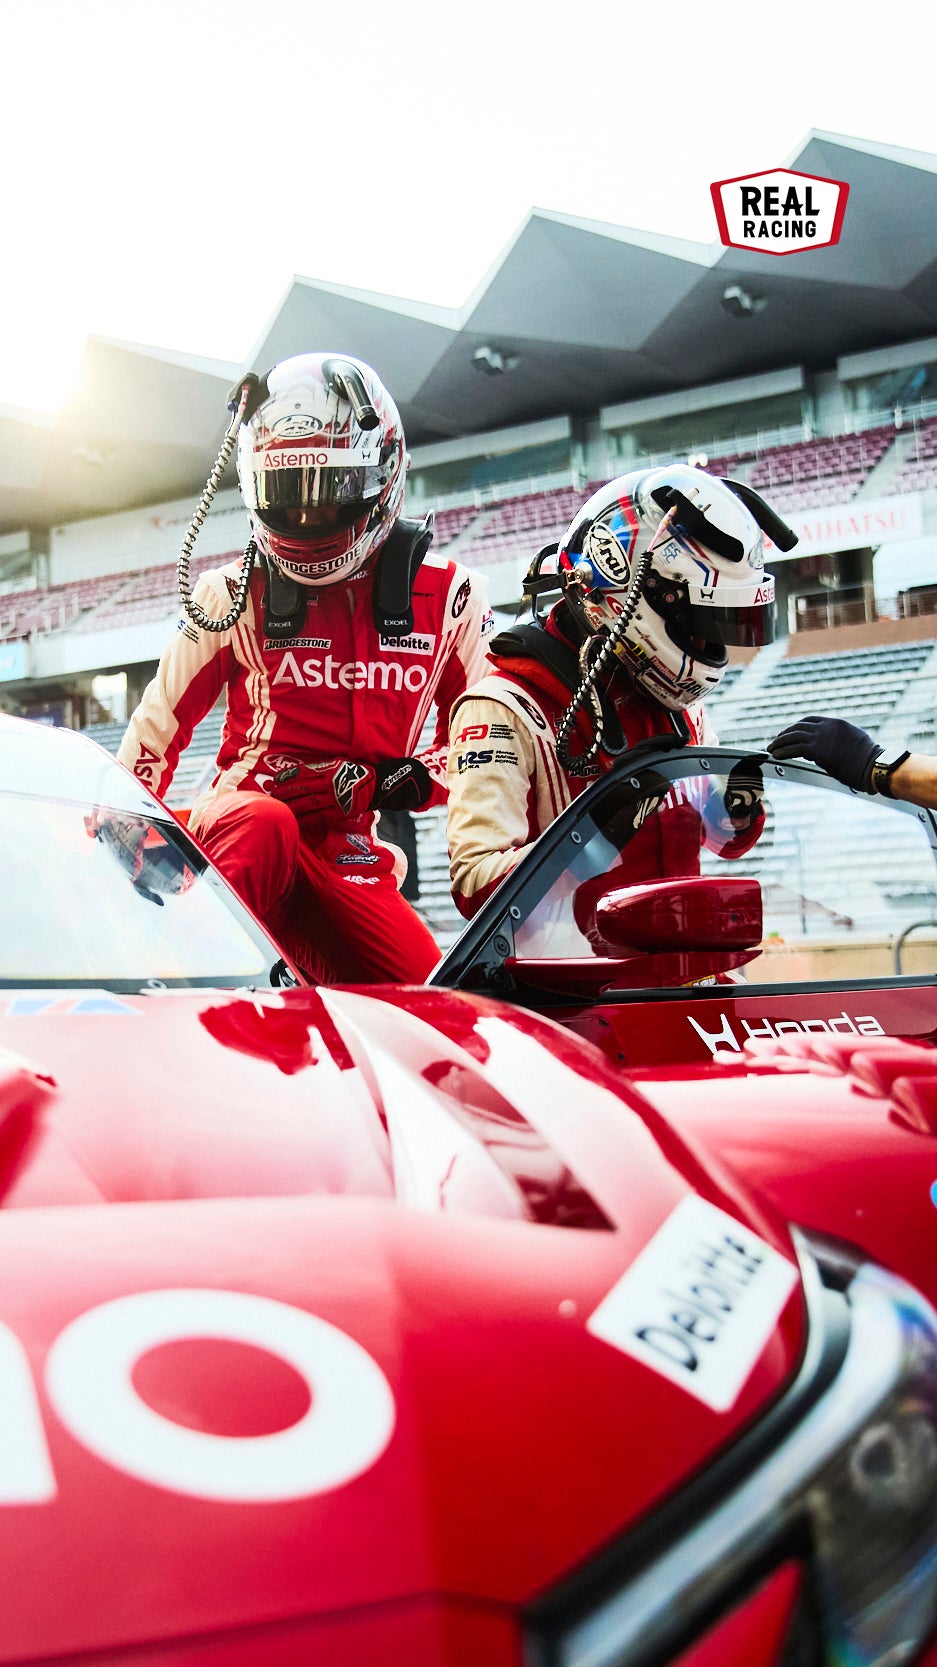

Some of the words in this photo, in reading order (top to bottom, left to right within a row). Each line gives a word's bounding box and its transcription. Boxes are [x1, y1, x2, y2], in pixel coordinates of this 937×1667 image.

[264, 453, 329, 468] Astemo
[803, 510, 906, 541] AIHATSU
[270, 547, 362, 574] BRIDGESTONE
[591, 528, 628, 577] Arai
[264, 638, 331, 650] BRIDGESTONE
[271, 651, 428, 693] Astemo
[741, 1012, 886, 1039] Honda
